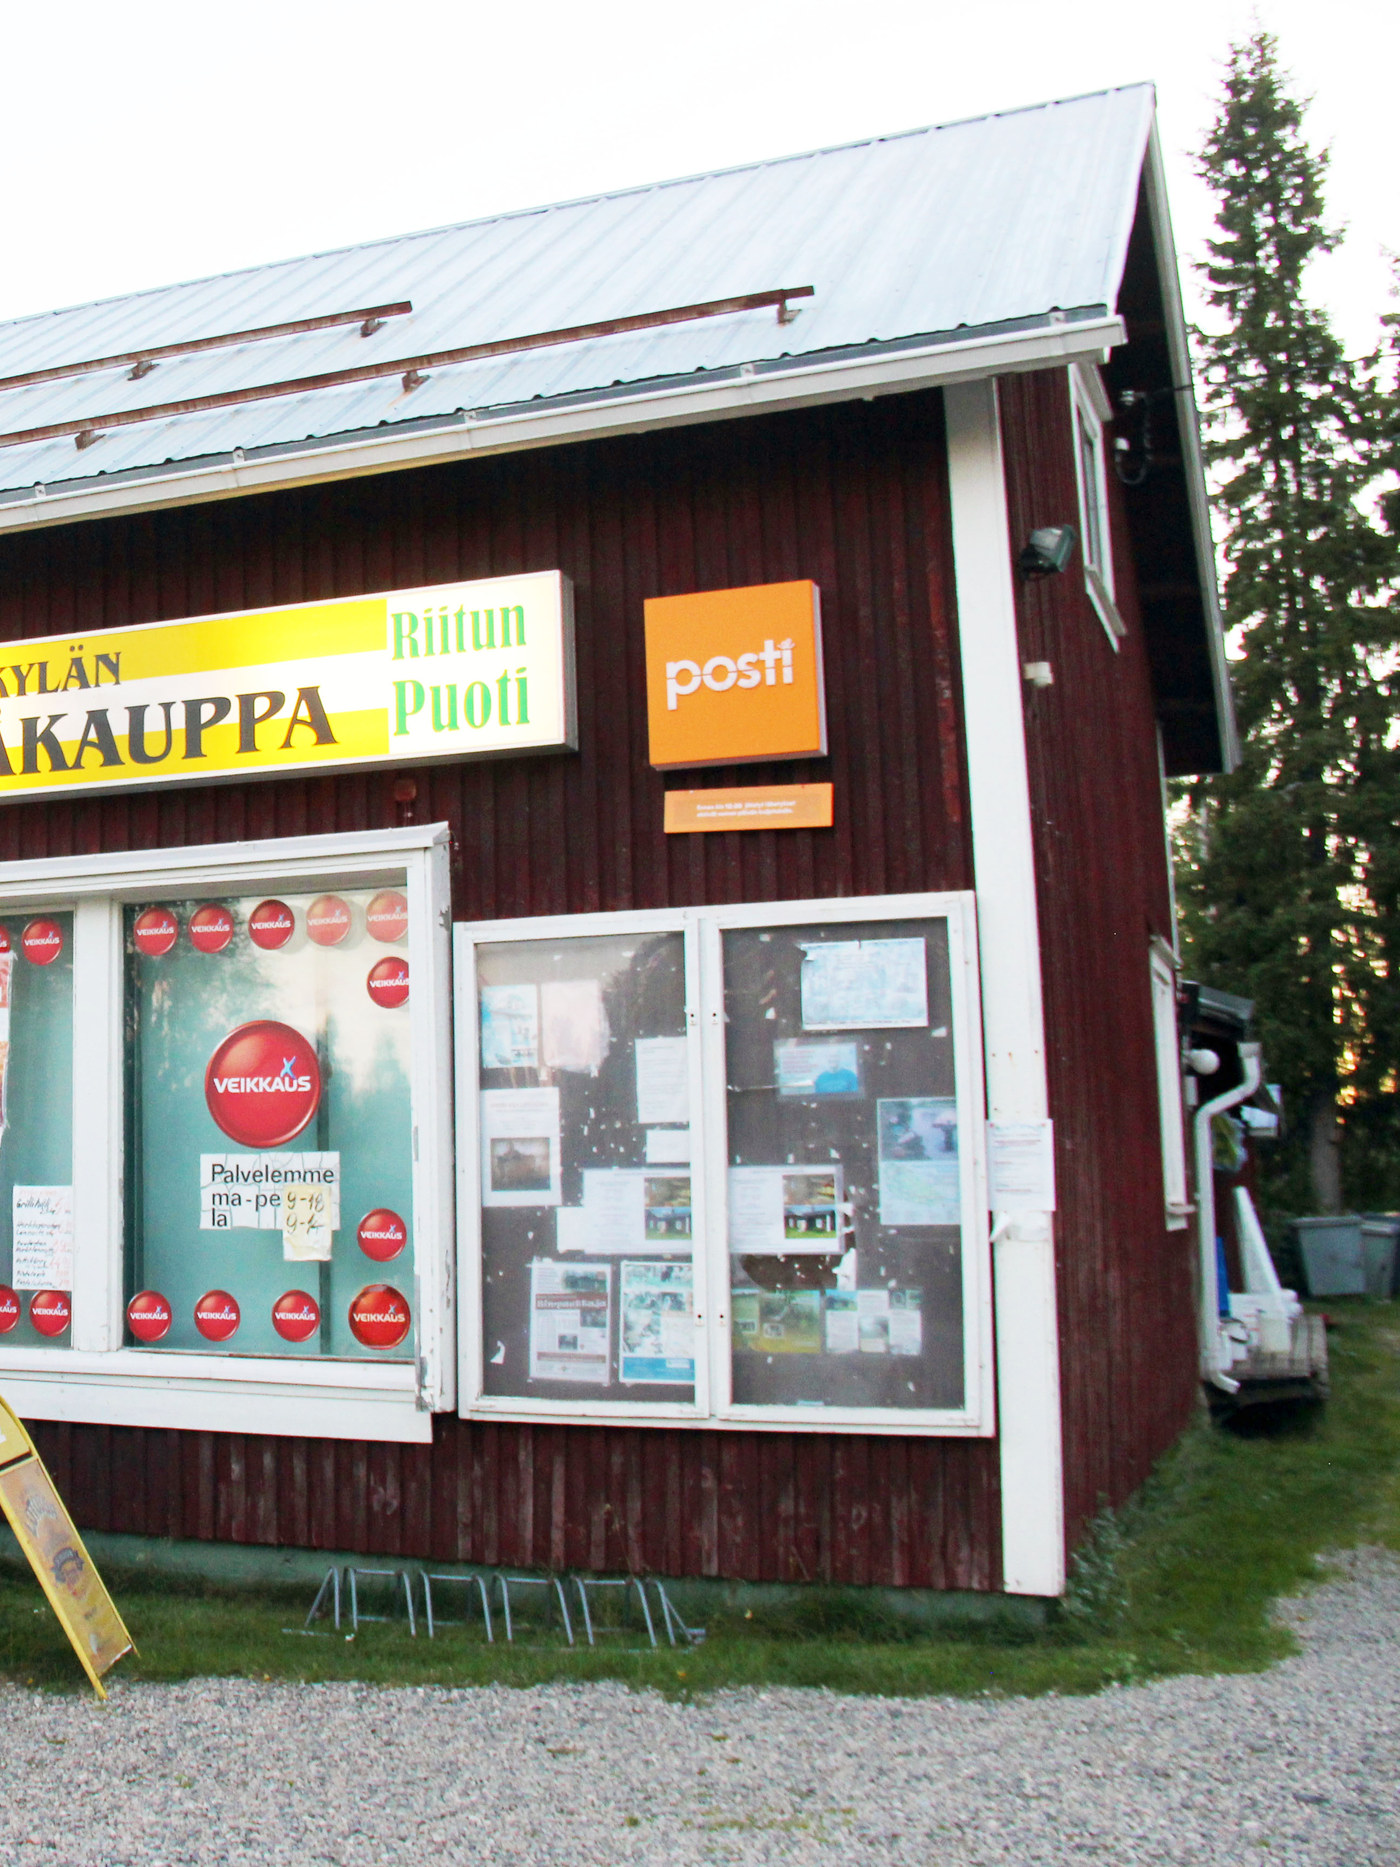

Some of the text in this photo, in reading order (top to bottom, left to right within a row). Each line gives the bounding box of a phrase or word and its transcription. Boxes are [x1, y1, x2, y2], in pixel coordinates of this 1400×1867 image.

[391, 604, 526, 660] Riitun
[666, 638, 795, 710] posti
[392, 668, 530, 737] Puoti
[251, 918, 291, 930] VEIKKAUS
[308, 913, 348, 926] VEIKKAUS
[136, 925, 174, 936] VEIKKAUS
[191, 922, 230, 933] VEIKKAUS
[25, 935, 60, 946] VEIKKAUS
[213, 1070, 311, 1093] VEIKKAUS
[211, 1163, 334, 1183] Palvelemme
[212, 1208, 228, 1227] la
[361, 1229, 402, 1240] VEIKKAUS
[32, 1305, 68, 1316] VEIKKAUS
[130, 1310, 168, 1320] VEIKKAUS
[197, 1310, 236, 1321] VEIKKAUS
[275, 1310, 315, 1321] VEIKKAUS
[353, 1311, 405, 1322] VEIKKAUS
